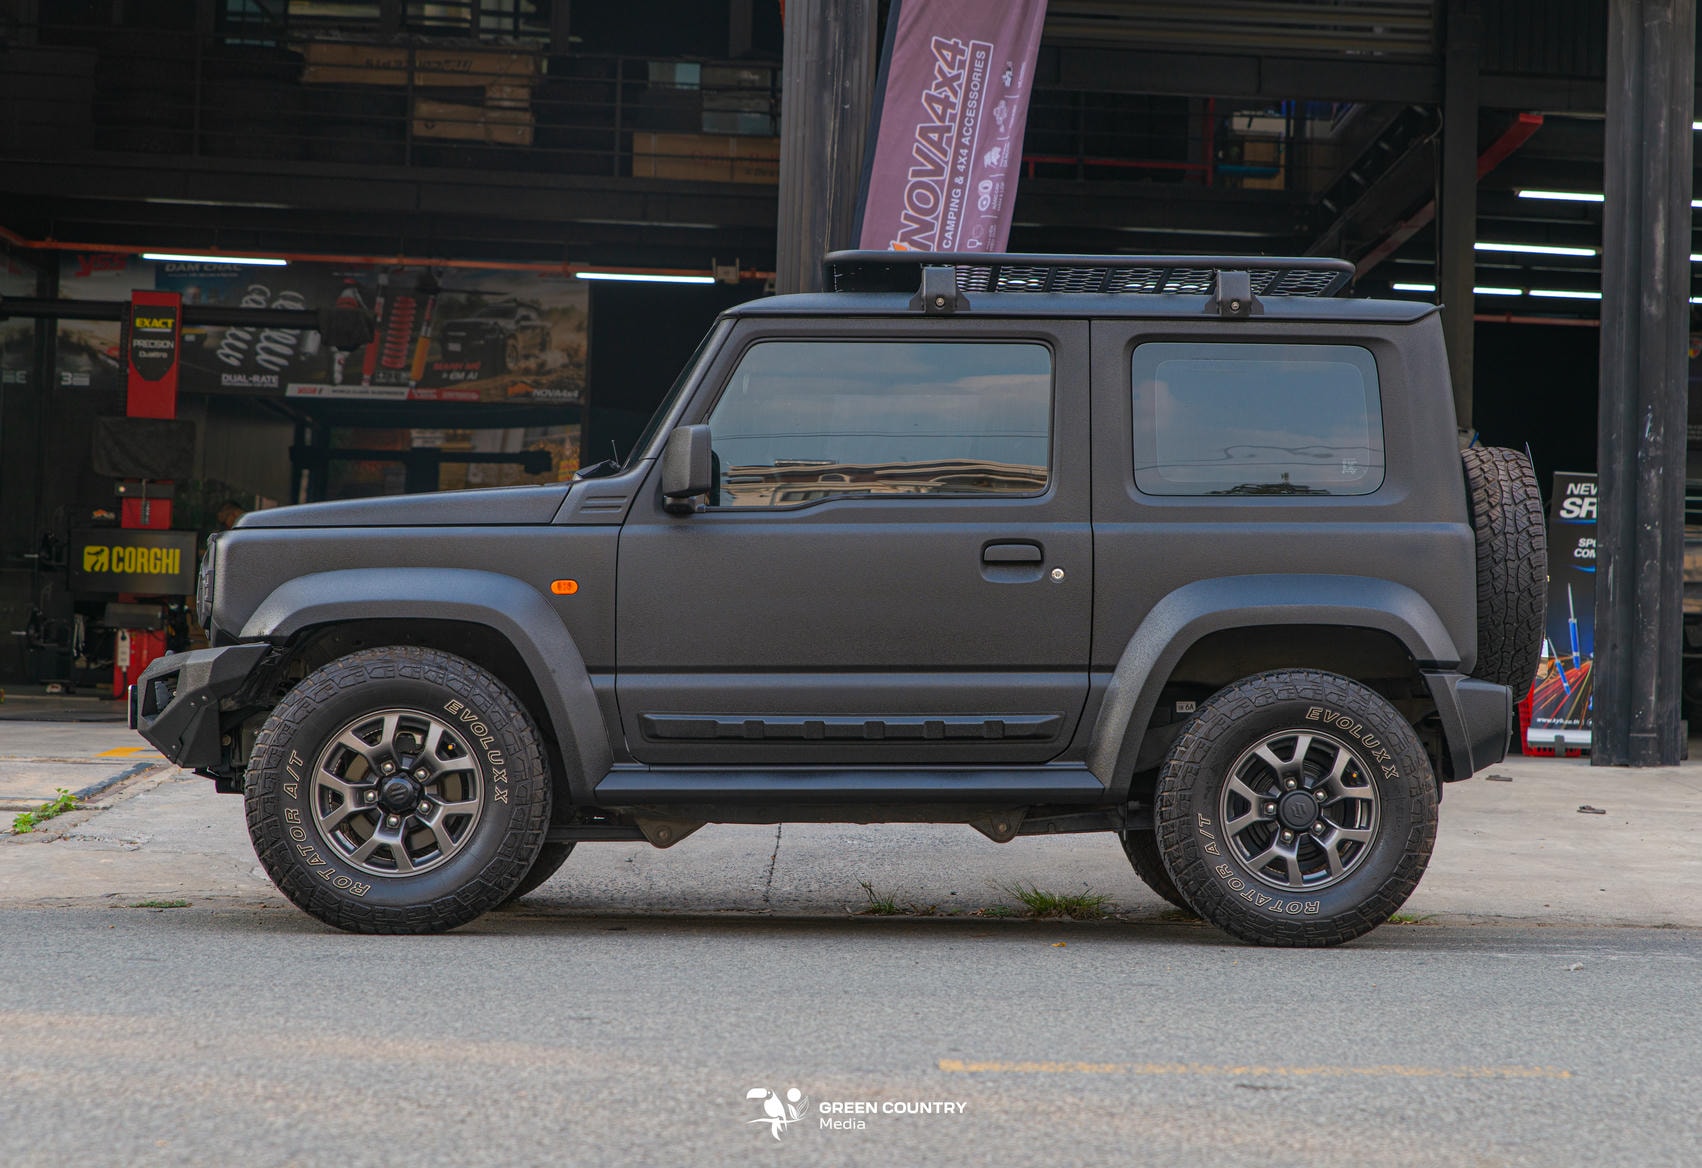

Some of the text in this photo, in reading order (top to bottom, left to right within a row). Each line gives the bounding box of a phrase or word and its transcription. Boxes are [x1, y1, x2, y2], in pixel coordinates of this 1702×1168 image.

[942, 50, 986, 249] CAMPING & 4X4 ACCESSORIES
[135, 316, 175, 329] EXACT
[221, 373, 279, 384] DUAL-RATE
[111, 546, 181, 575] CORGHI
[443, 699, 508, 804] EVOLUXX
[1305, 706, 1399, 780] EVOLUXX
[283, 750, 371, 897] ROTATOR A/T
[1197, 813, 1320, 914] ROTATOR A/T
